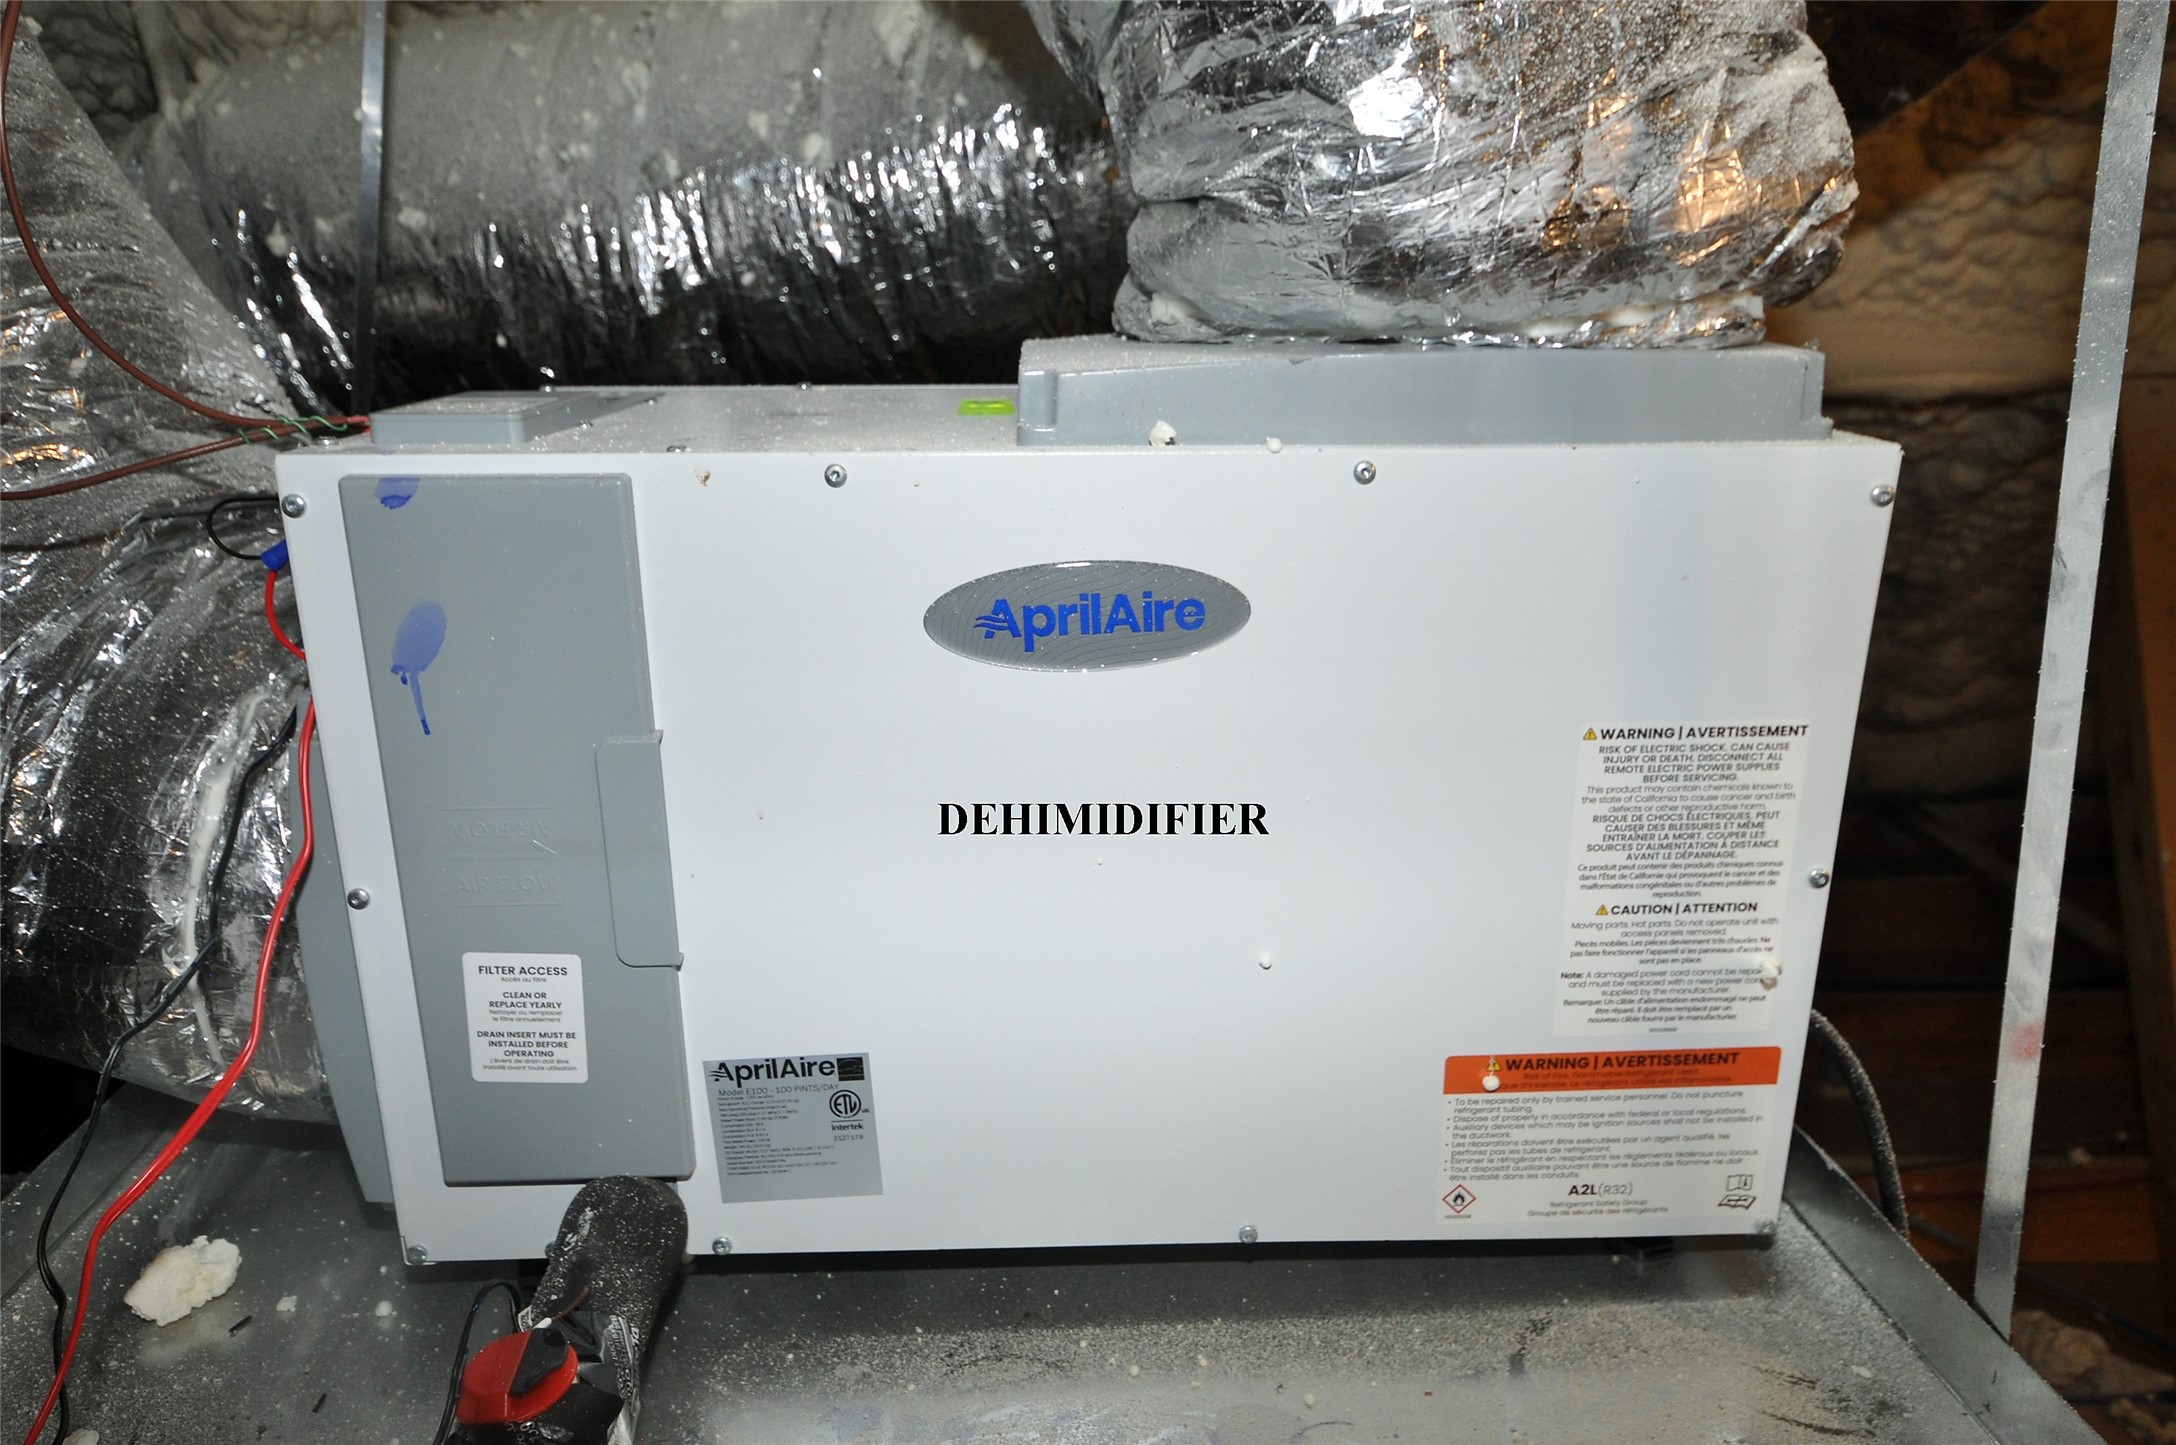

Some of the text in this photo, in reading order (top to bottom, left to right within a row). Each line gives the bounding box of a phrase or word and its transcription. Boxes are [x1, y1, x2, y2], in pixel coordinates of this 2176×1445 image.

[974, 591, 1206, 652] AprilAire
[1600, 725, 1808, 740] WARNING AVERTISSEMENT
[1599, 745, 1620, 754] RISK
[1623, 745, 1636, 754] OF
[1640, 744, 1684, 754] ELECTRIC
[1730, 743, 1753, 752] CAN
[1755, 742, 1790, 752] CAUSE
[1603, 754, 1639, 764] INJURY
[1642, 754, 1657, 763] OR
[1697, 753, 1764, 763] DISCONNECT
[1767, 752, 1783, 762] ALL
[1604, 763, 1780, 774] REMOTE ELECTRIC POWER SUPPLIES
[1642, 774, 1679, 784] BEFORE
[1588, 782, 1793, 796] This product may contain chemicals known to
[1592, 814, 1628, 824] RISQUE
[1631, 813, 1643, 823] DE
[1646, 813, 1682, 822] CHOCS
[1755, 811, 1780, 820] PEUT
[1586, 843, 1632, 852] SOURCES
[1730, 840, 1780, 850] DISTANCE
[1626, 851, 1659, 861] AVANT
[1662, 851, 1672, 860] LE
[1611, 902, 1758, 915] CAUTION ATTENTION
[1571, 920, 1602, 932] Moving
[1631, 920, 1645, 928] Hot
[1674, 919, 1686, 928] Do
[1688, 919, 1702, 927] not
[1705, 918, 1740, 929] operate
[1742, 918, 1758, 926] unit
[1760, 917, 1778, 926] with
[1654, 929, 1683, 940] panels
[478, 966, 568, 976] FILTER ACCESS
[488, 1040, 534, 1048] INSTALLED
[1506, 1052, 1738, 1071] WARNING AVERTISSEMENT
[709, 1057, 835, 1088] AprilAire
[718, 1088, 746, 1096] Model
[746, 1087, 768, 1096] E100
[776, 1086, 791, 1094] 100
[1455, 1097, 1464, 1106] To
[1467, 1097, 1478, 1106] be
[1481, 1096, 1519, 1107] repaired
[1522, 1095, 1540, 1106] only
[1542, 1095, 1553, 1105] by
[1555, 1094, 1587, 1103] trained
[1589, 1093, 1620, 1102] service
[1671, 1091, 1682, 1100] Do
[1686, 1090, 1700, 1099] not
[1702, 1089, 1742, 1101] puncture
[1453, 1105, 1500, 1116] refrigerant
[1453, 1113, 1488, 1125] Dispose
[1490, 1113, 1499, 1122] of
[1501, 1112, 1538, 1124] properly
[1541, 1112, 1548, 1121] in
[1550, 1110, 1604, 1120] accordance
[1608, 1110, 1624, 1119] with
[1628, 1109, 1658, 1118] federal
[1672, 1108, 1694, 1117] local
[831, 1123, 864, 1132] Intertek
